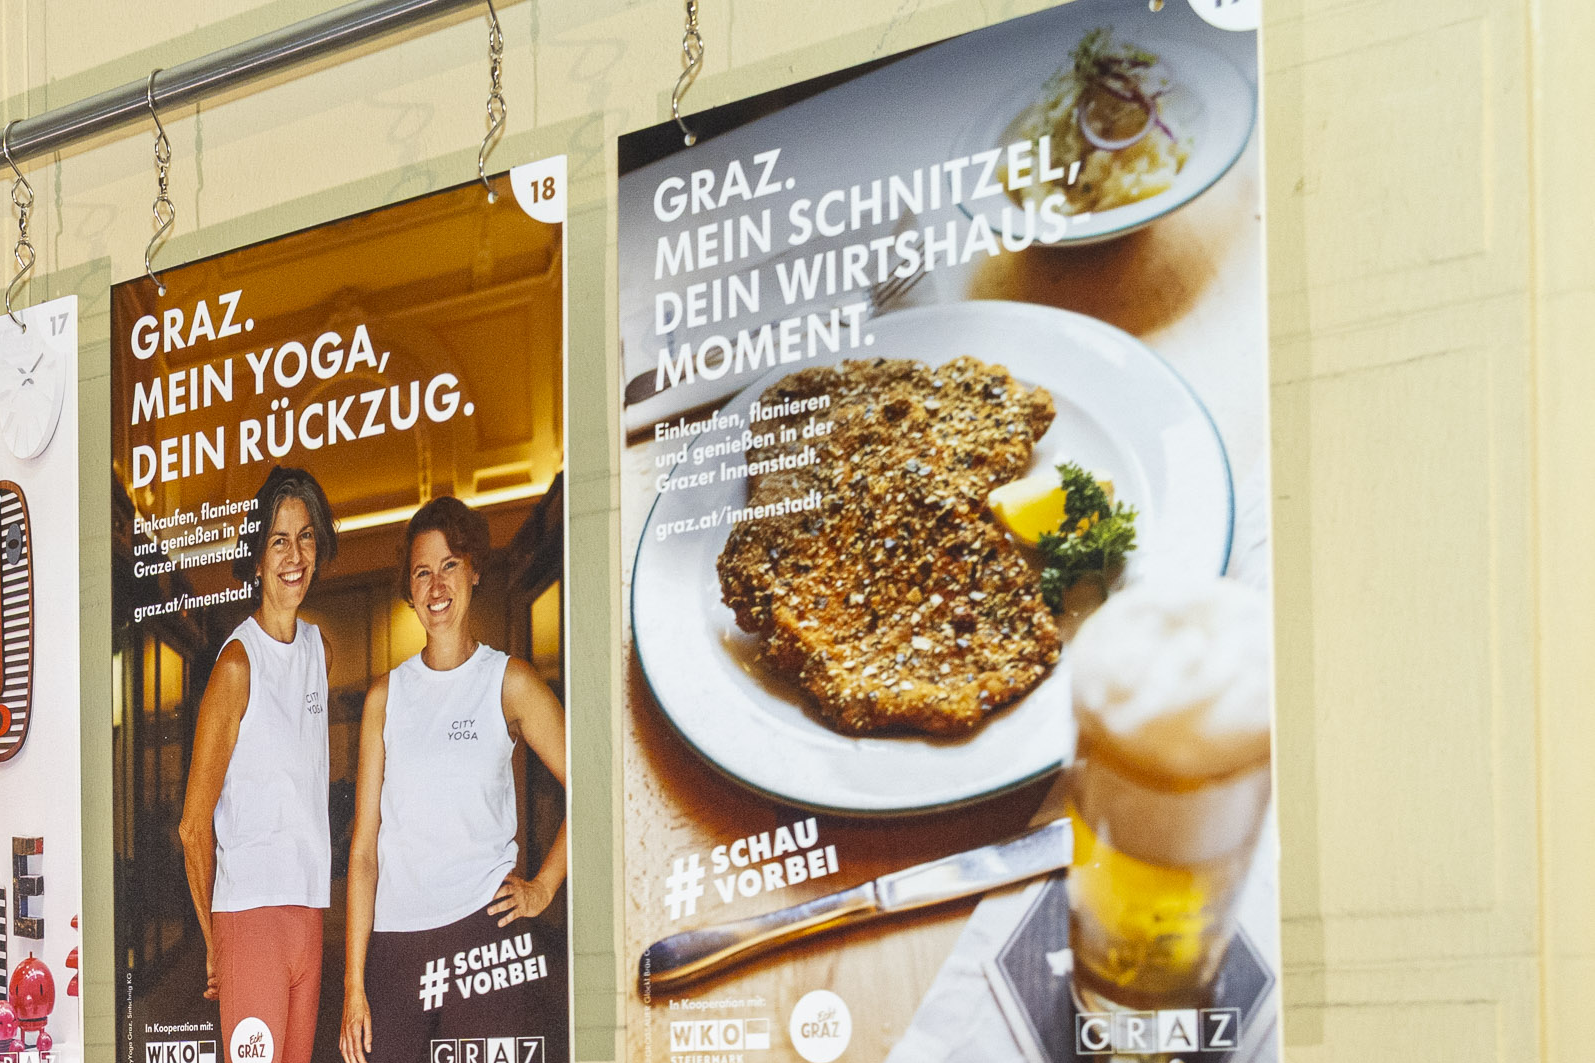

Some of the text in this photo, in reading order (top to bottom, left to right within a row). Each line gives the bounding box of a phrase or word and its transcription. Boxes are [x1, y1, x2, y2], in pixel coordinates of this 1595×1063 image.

[530, 176, 556, 204] 18
[654, 148, 796, 222] GRAZ.
[654, 135, 1081, 280] MEIN SCHNITZEL,
[654, 193, 1091, 335] DEIN WIRTSHAUS-
[50, 312, 69, 337] 17
[131, 289, 255, 360] GRAZ.
[654, 303, 875, 391] MOMENT.
[131, 324, 391, 425] MEIN YOGA,
[132, 372, 475, 489] DEIN RÜCKZUG.
[448, 730, 478, 740] YOGA
[452, 720, 475, 729] CITY
